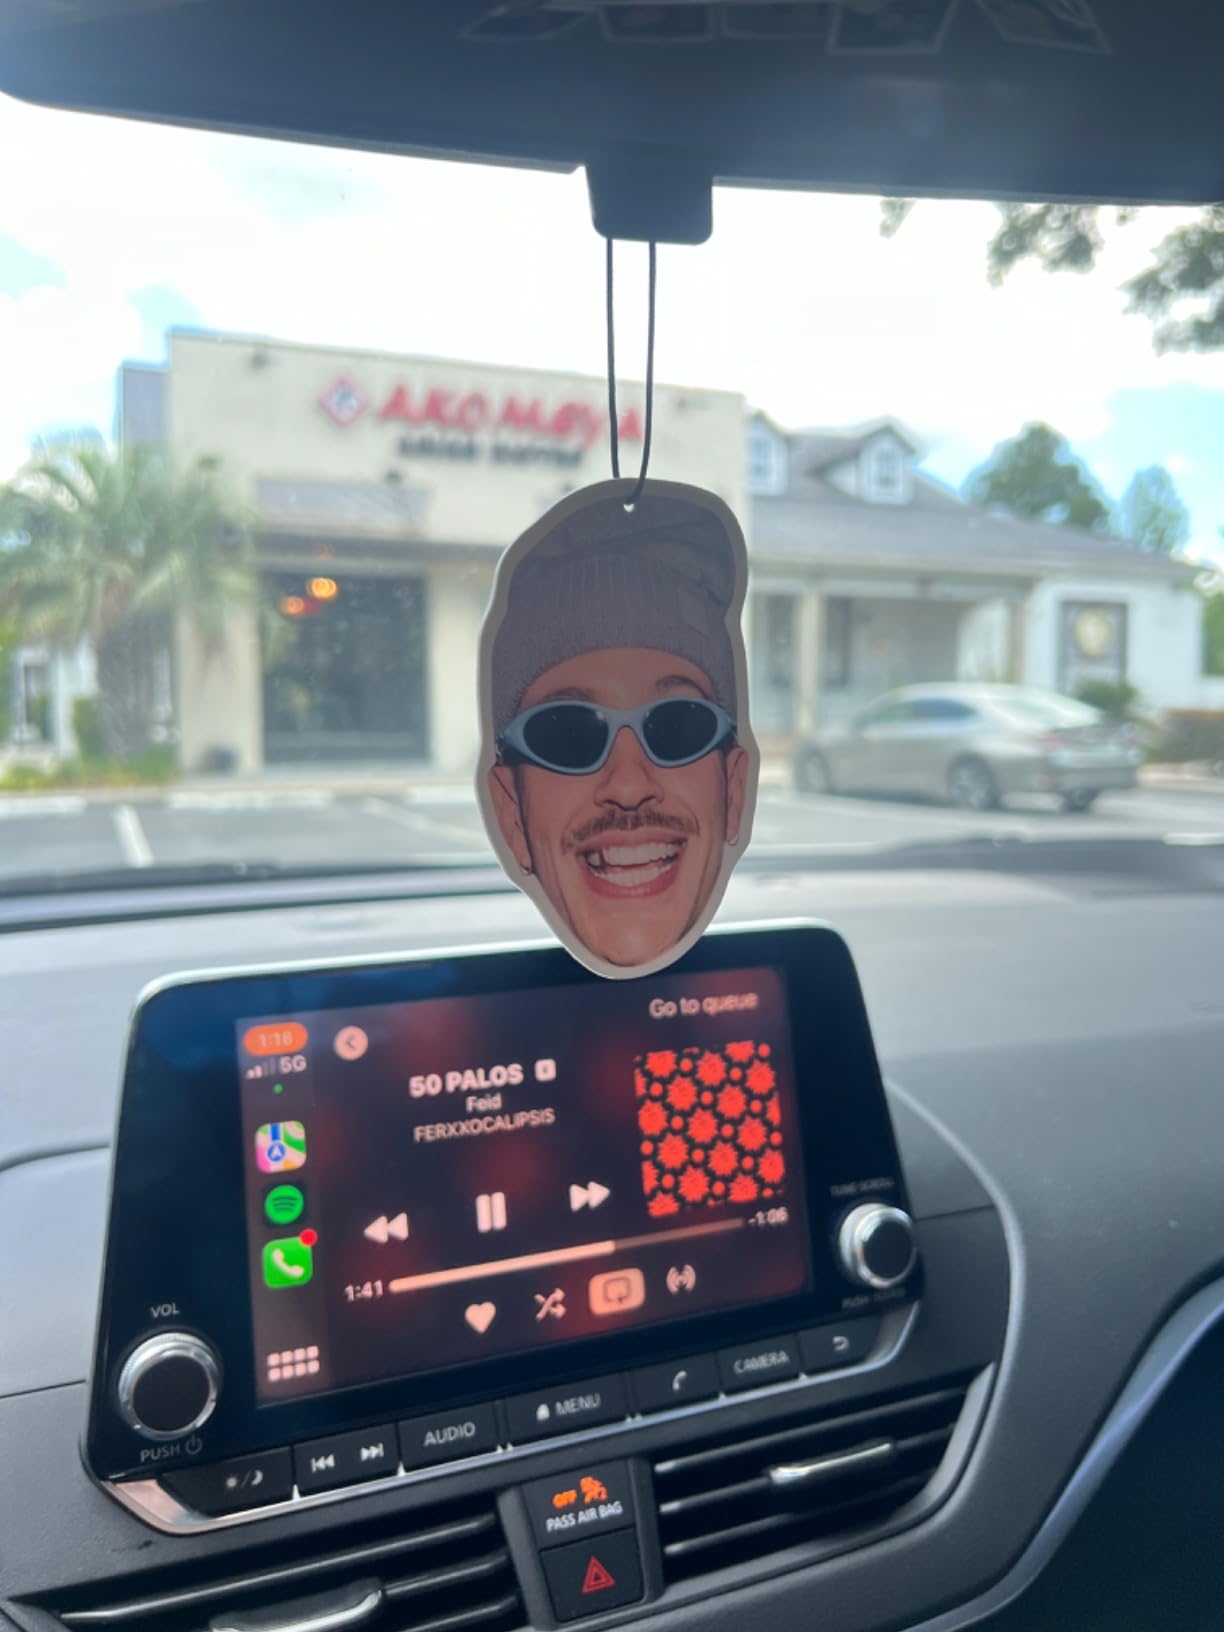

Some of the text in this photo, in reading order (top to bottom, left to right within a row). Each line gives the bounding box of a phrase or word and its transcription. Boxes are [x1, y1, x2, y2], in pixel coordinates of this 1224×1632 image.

[649, 992, 758, 1019] Go to queue
[279, 1055, 307, 1074] 5G
[409, 1074, 442, 1097] 50
[446, 1063, 523, 1092] PALOS
[466, 1093, 502, 1112] Feid
[414, 1108, 555, 1143] FERXXOCALIPSIS
[344, 1280, 383, 1301] 1:41
[151, 1303, 180, 1318] VOL
[734, 1349, 790, 1374] CAMERA
[555, 1393, 600, 1416] MENU
[423, 1421, 476, 1447] AUDIO
[140, 1445, 182, 1464] PUSH
[546, 1500, 624, 1533] PASS AIR BAG
